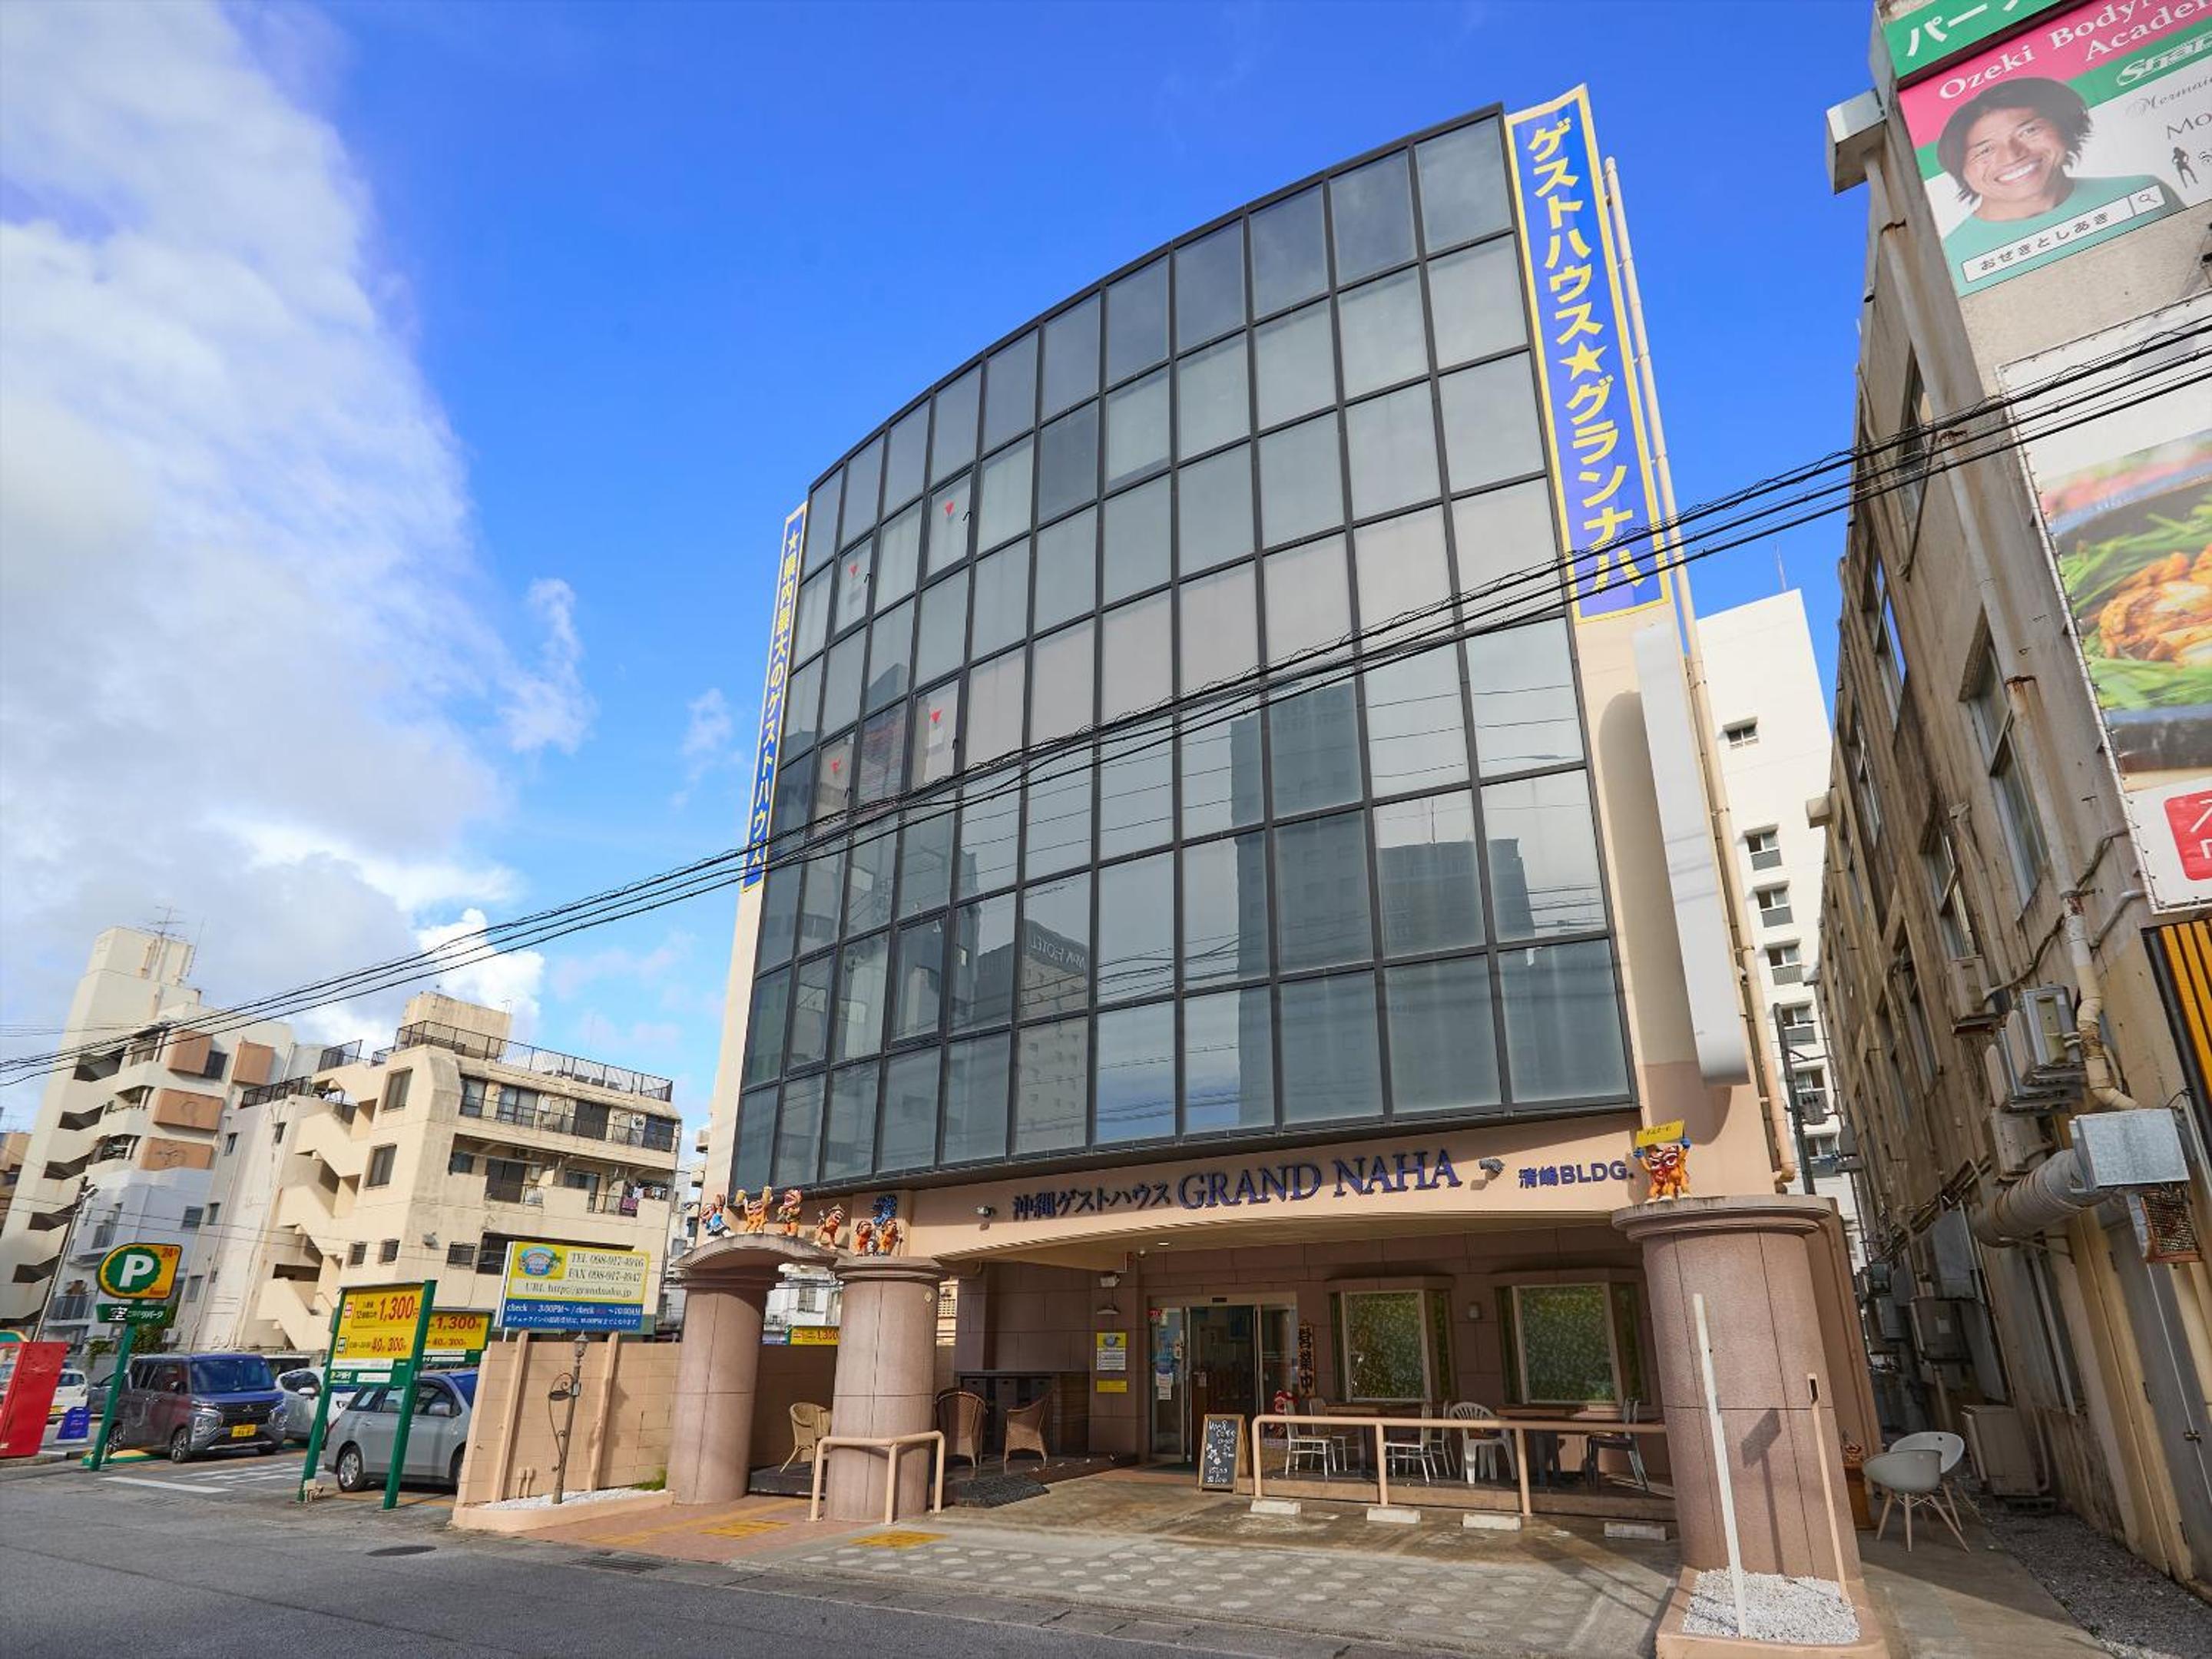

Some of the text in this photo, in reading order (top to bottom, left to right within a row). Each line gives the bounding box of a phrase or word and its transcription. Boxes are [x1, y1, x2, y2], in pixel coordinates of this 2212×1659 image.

[1907, 0, 2018, 57] パー
[1939, 0, 2150, 100] Ozeki Body
[1178, 1164, 1321, 1210] GRAND
[1333, 1148, 1462, 1198] NAHA
[118, 1253, 154, 1288] P
[568, 1267, 586, 1279] FAX
[571, 1253, 588, 1263] TEL
[507, 1303, 528, 1312] check
